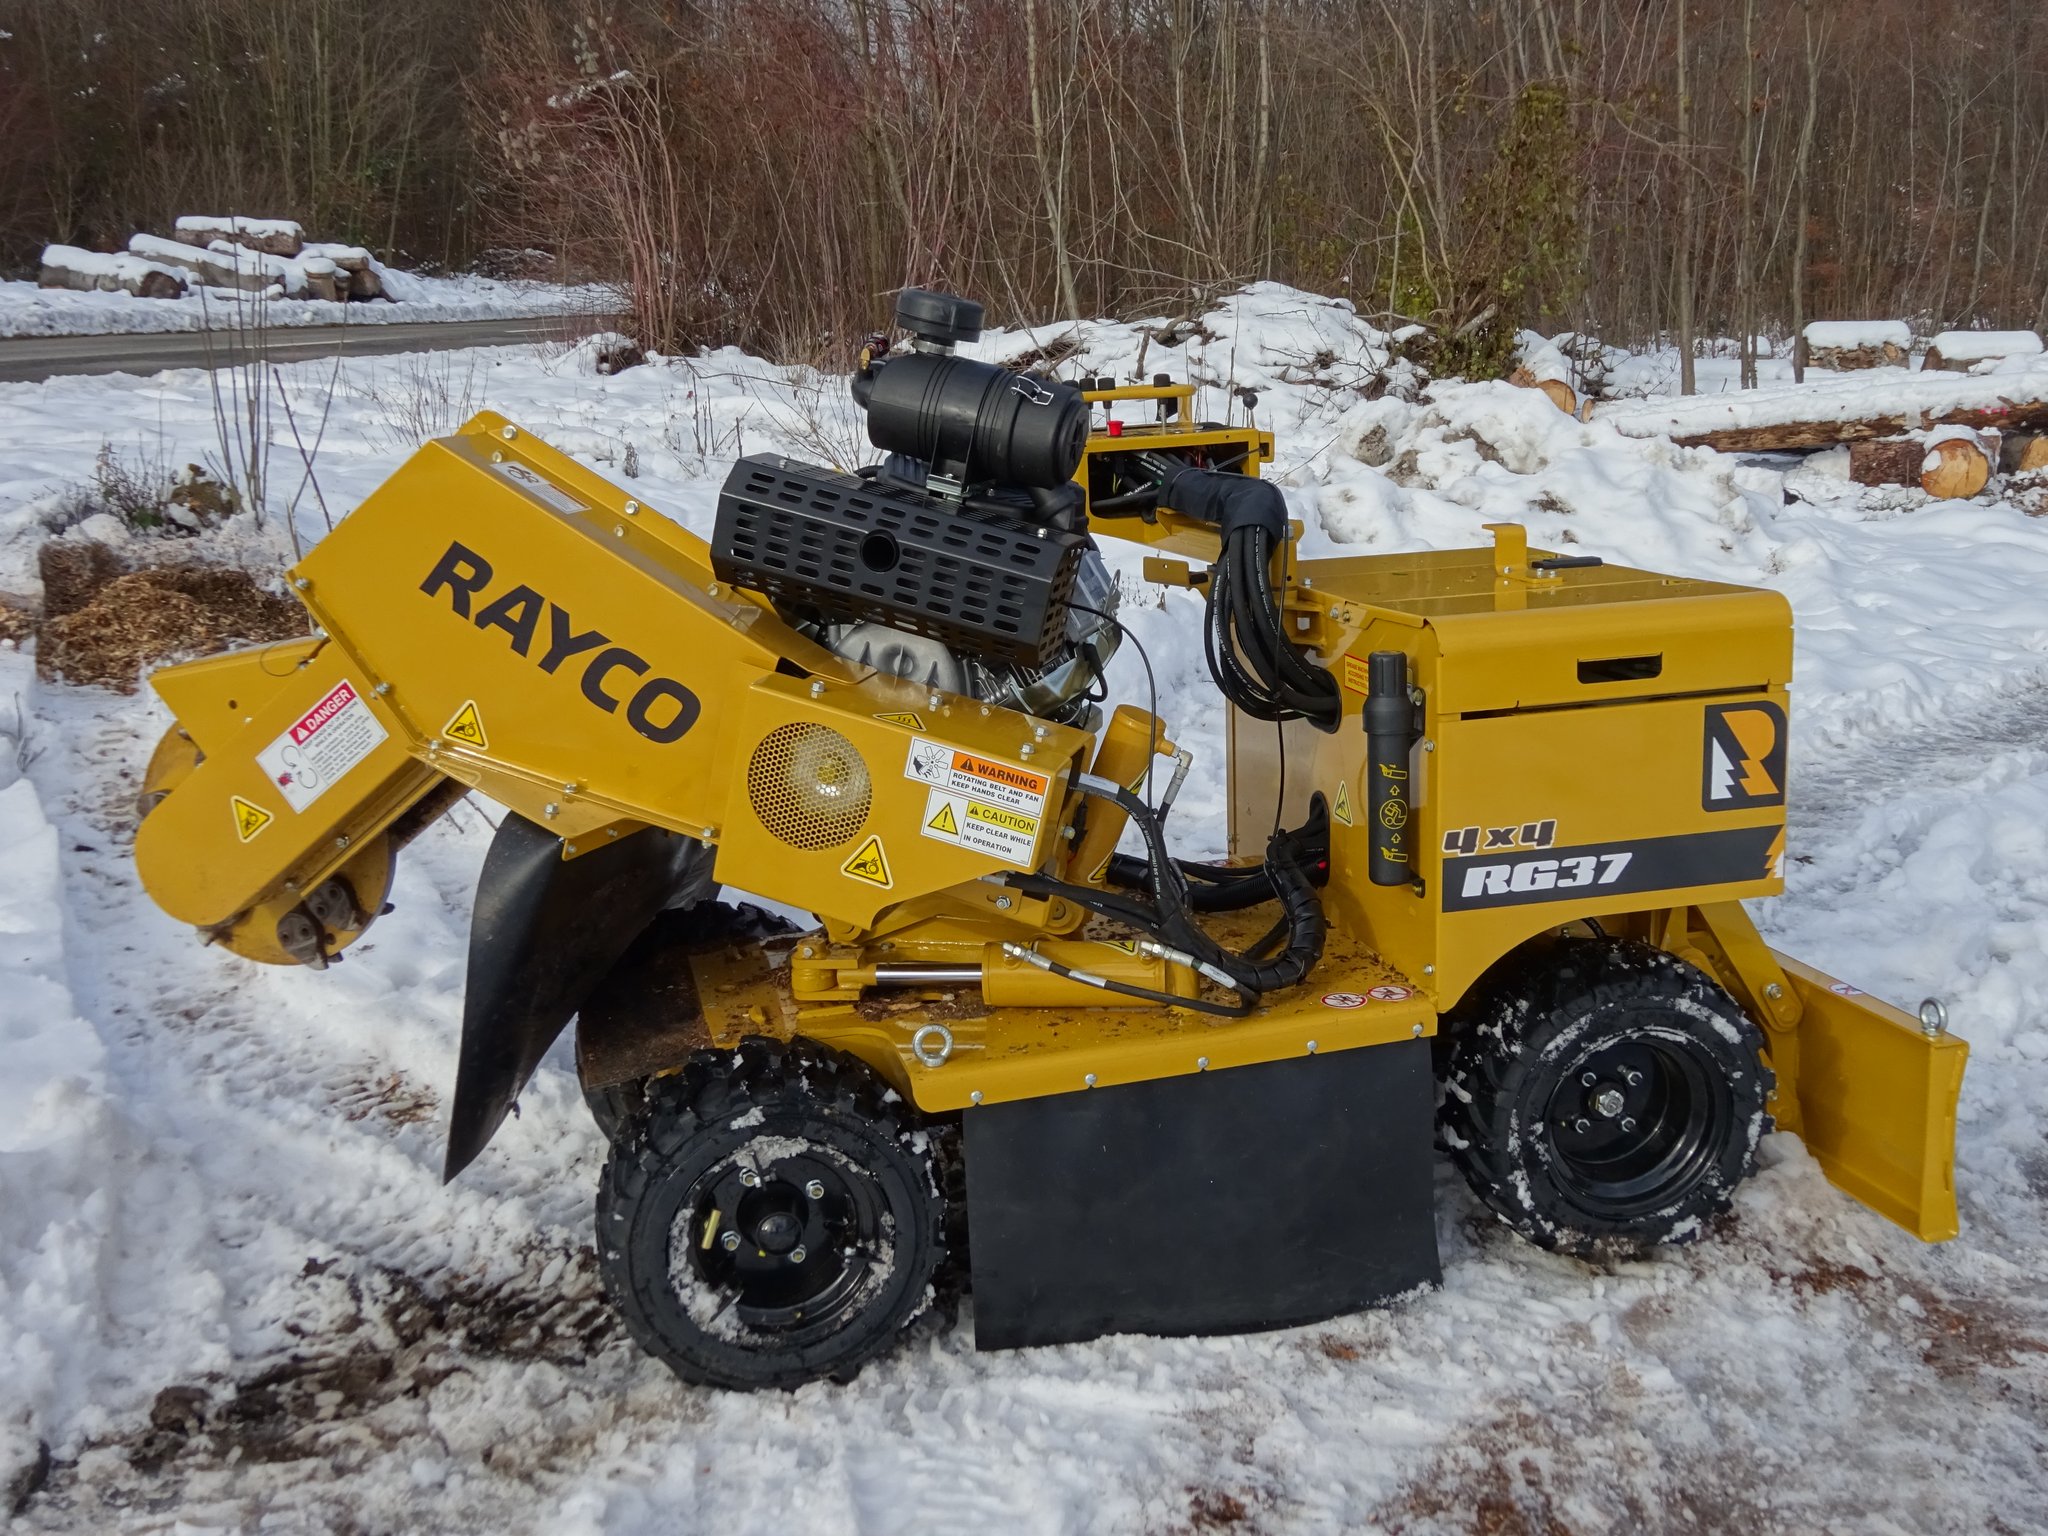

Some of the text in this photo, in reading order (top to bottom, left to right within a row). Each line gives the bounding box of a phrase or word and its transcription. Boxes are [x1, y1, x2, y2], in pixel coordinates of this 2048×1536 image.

[419, 540, 701, 743] RAYCO
[305, 689, 352, 731] DANGER
[953, 772, 1039, 802] ROTATING BELT AND FAN
[978, 763, 1038, 790] WARNING
[951, 780, 1020, 805] KEEP HANDS CLEAR
[966, 822, 1032, 846] KEEP CLEAR WHILE
[982, 809, 1035, 832] CAUTION
[963, 834, 1012, 854] IN OPERATION
[1442, 819, 1557, 856] 4x4
[1461, 852, 1633, 898] RG37
